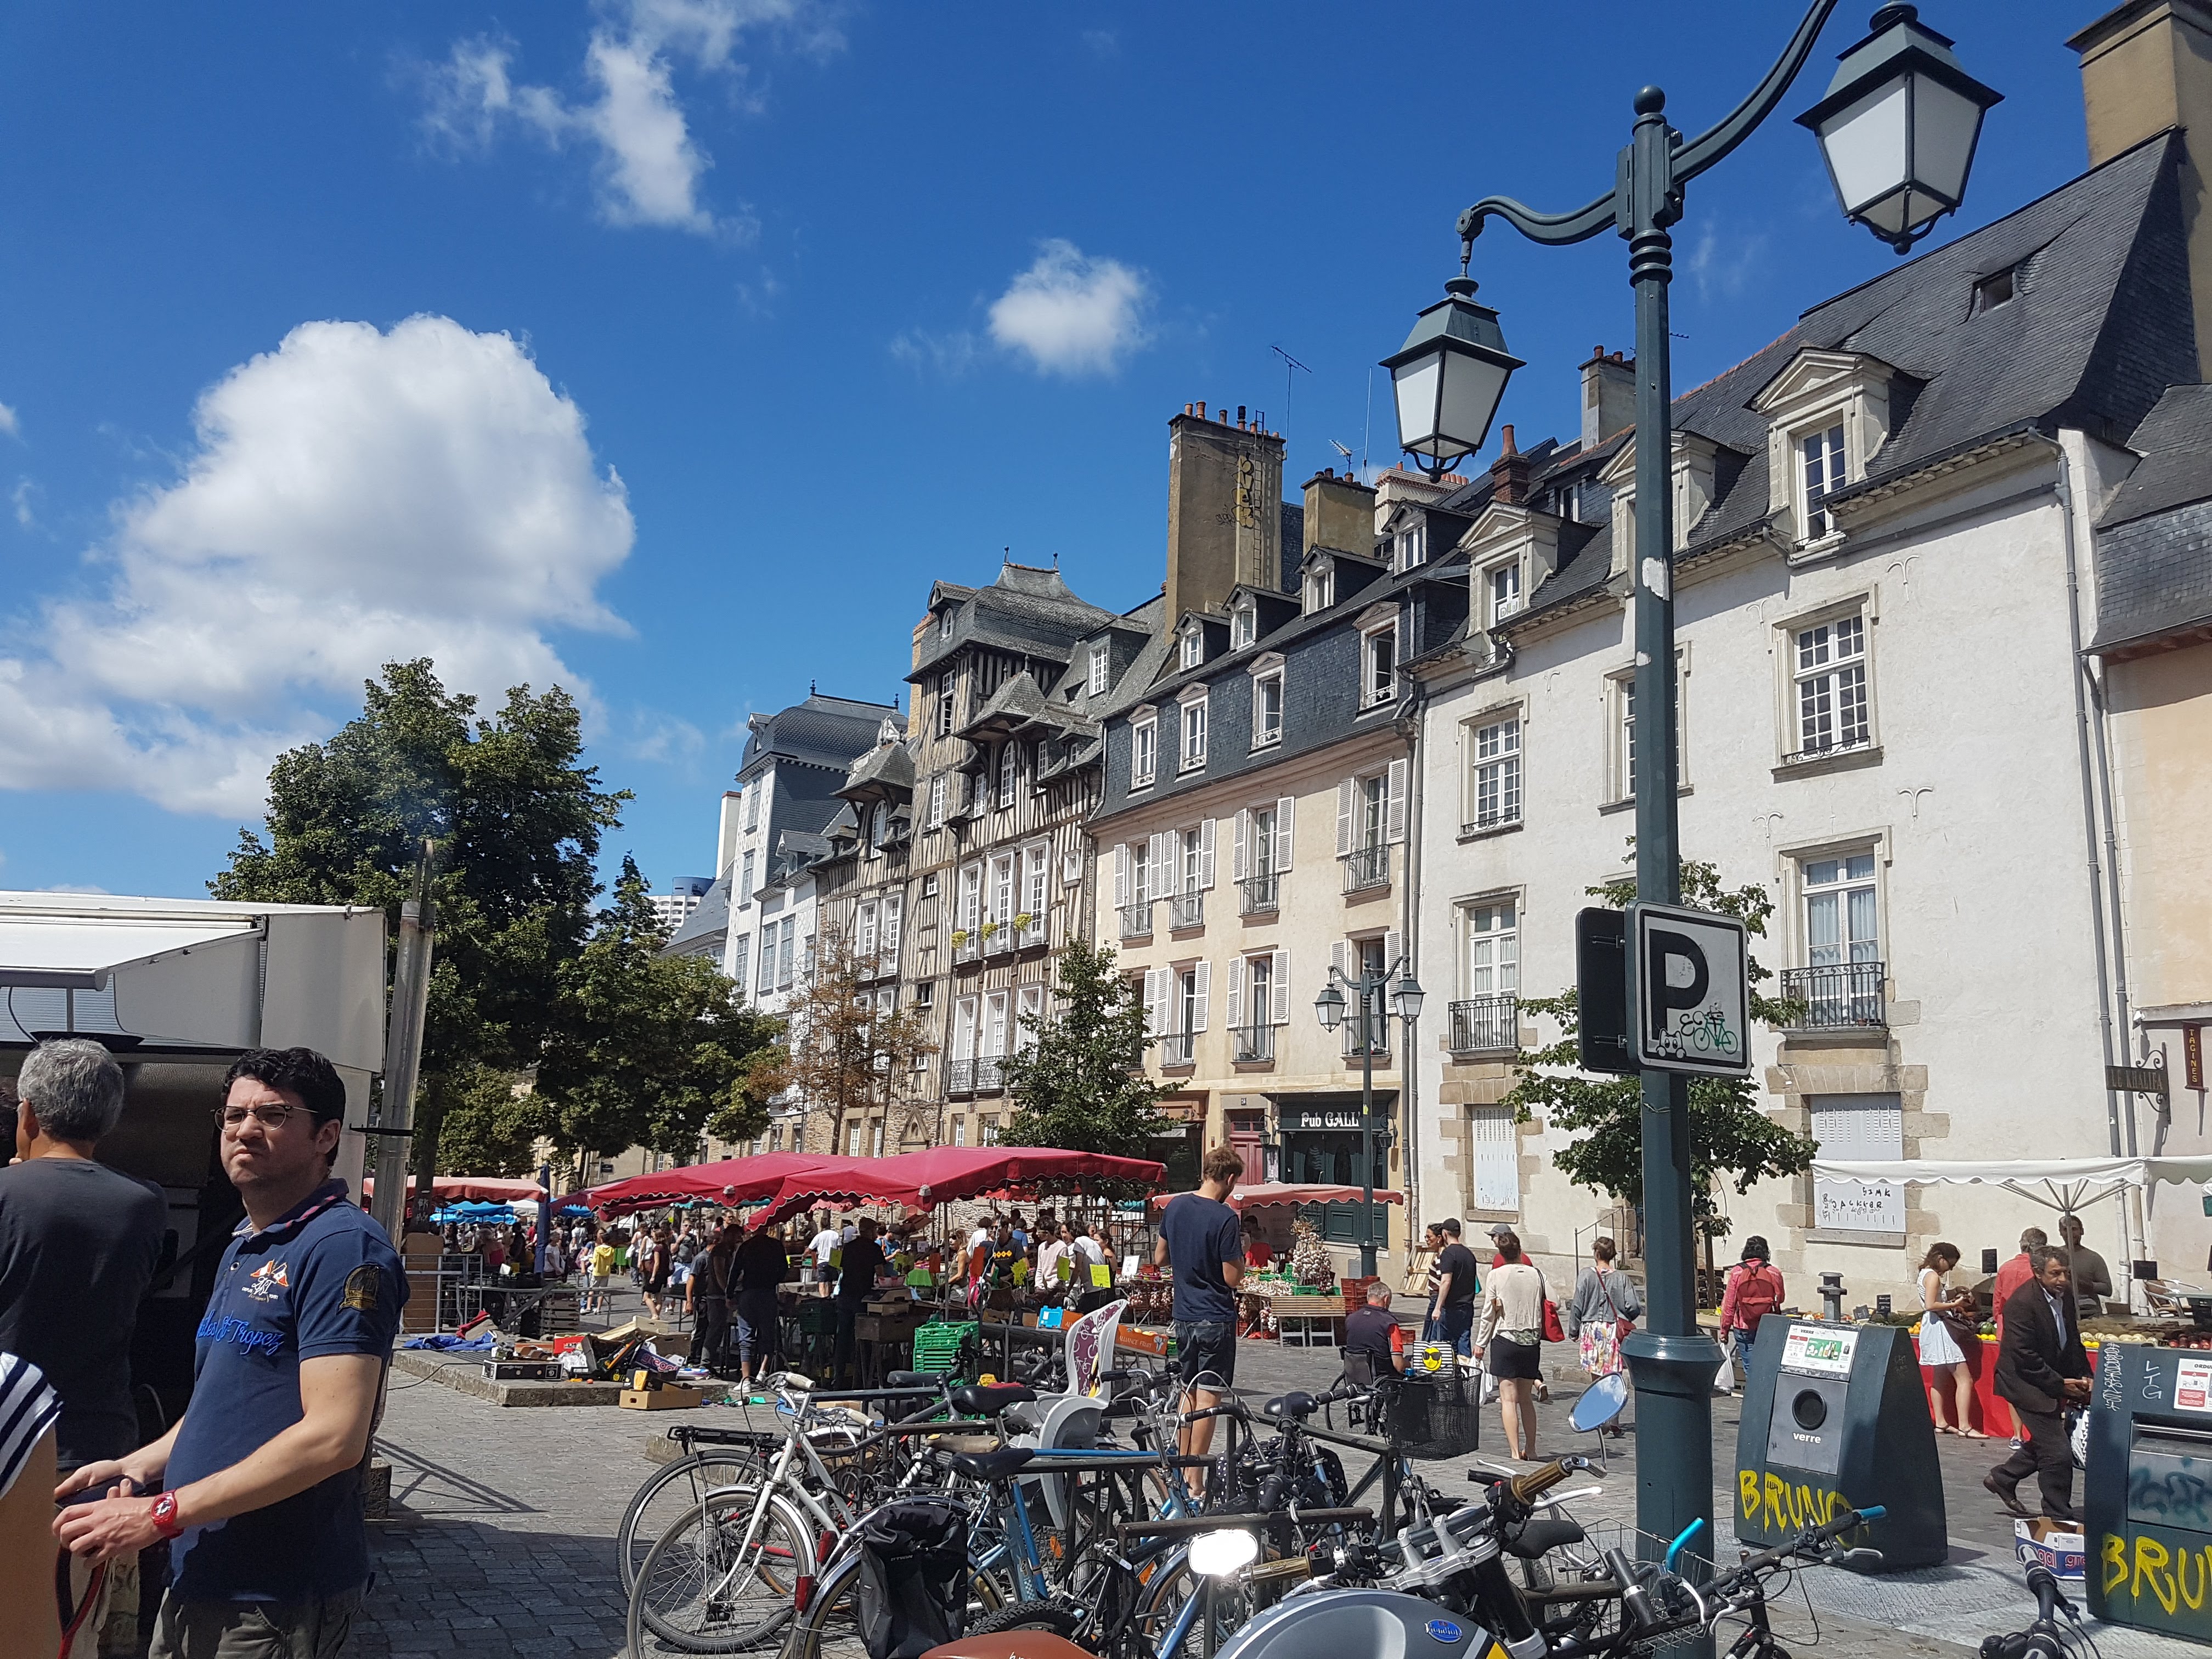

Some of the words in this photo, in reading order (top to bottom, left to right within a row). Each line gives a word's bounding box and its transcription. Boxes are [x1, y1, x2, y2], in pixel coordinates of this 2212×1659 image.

[1649, 929, 1709, 1041] P
[2188, 1029, 2198, 1083] TAGINES
[2112, 1069, 2123, 1088] LE
[2126, 1070, 2163, 1090] KHALIFA
[1301, 1111, 1322, 1127] Pub
[1120, 1335, 1138, 1345] ALLIANCE
[1139, 1340, 1152, 1348] FRUIT
[1793, 1432, 1821, 1444] verre
[2101, 1532, 2212, 1616] BRU
